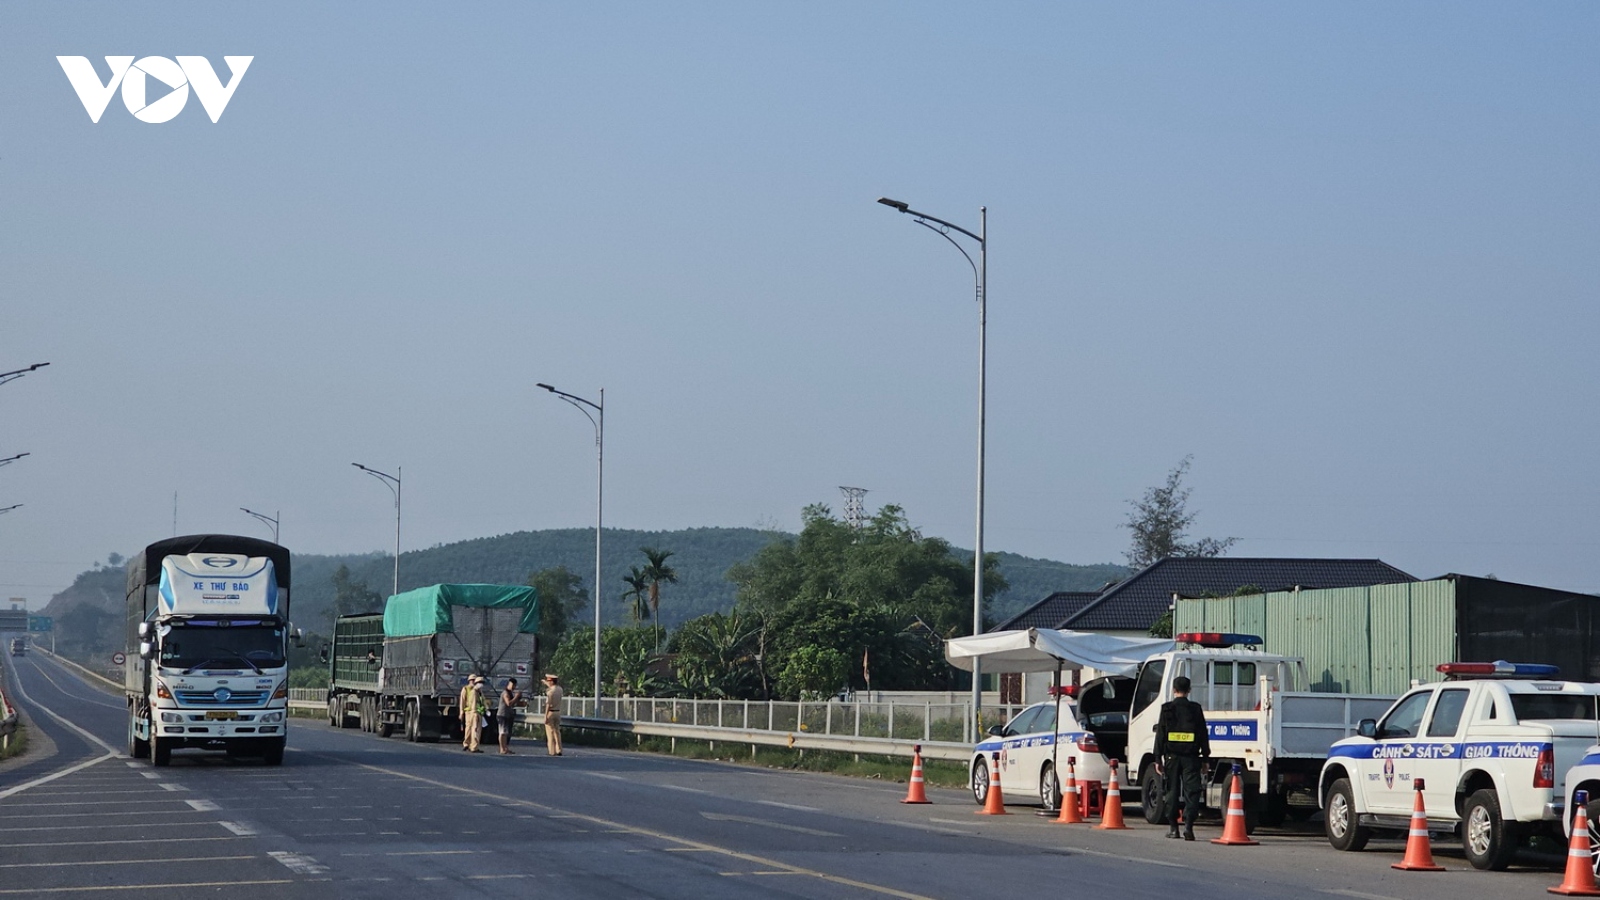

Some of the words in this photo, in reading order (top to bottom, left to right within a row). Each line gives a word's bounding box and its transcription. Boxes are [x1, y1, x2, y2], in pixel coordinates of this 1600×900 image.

[193, 581, 203, 590] XE
[210, 581, 226, 591] THƯ
[1214, 725, 1228, 736] GIAO
[1231, 723, 1251, 736] THÔNG
[1372, 744, 1402, 759] CẢNH
[1416, 744, 1441, 759] SÁT
[1465, 745, 1493, 759] GIAO
[1497, 742, 1540, 758] THÔNG
